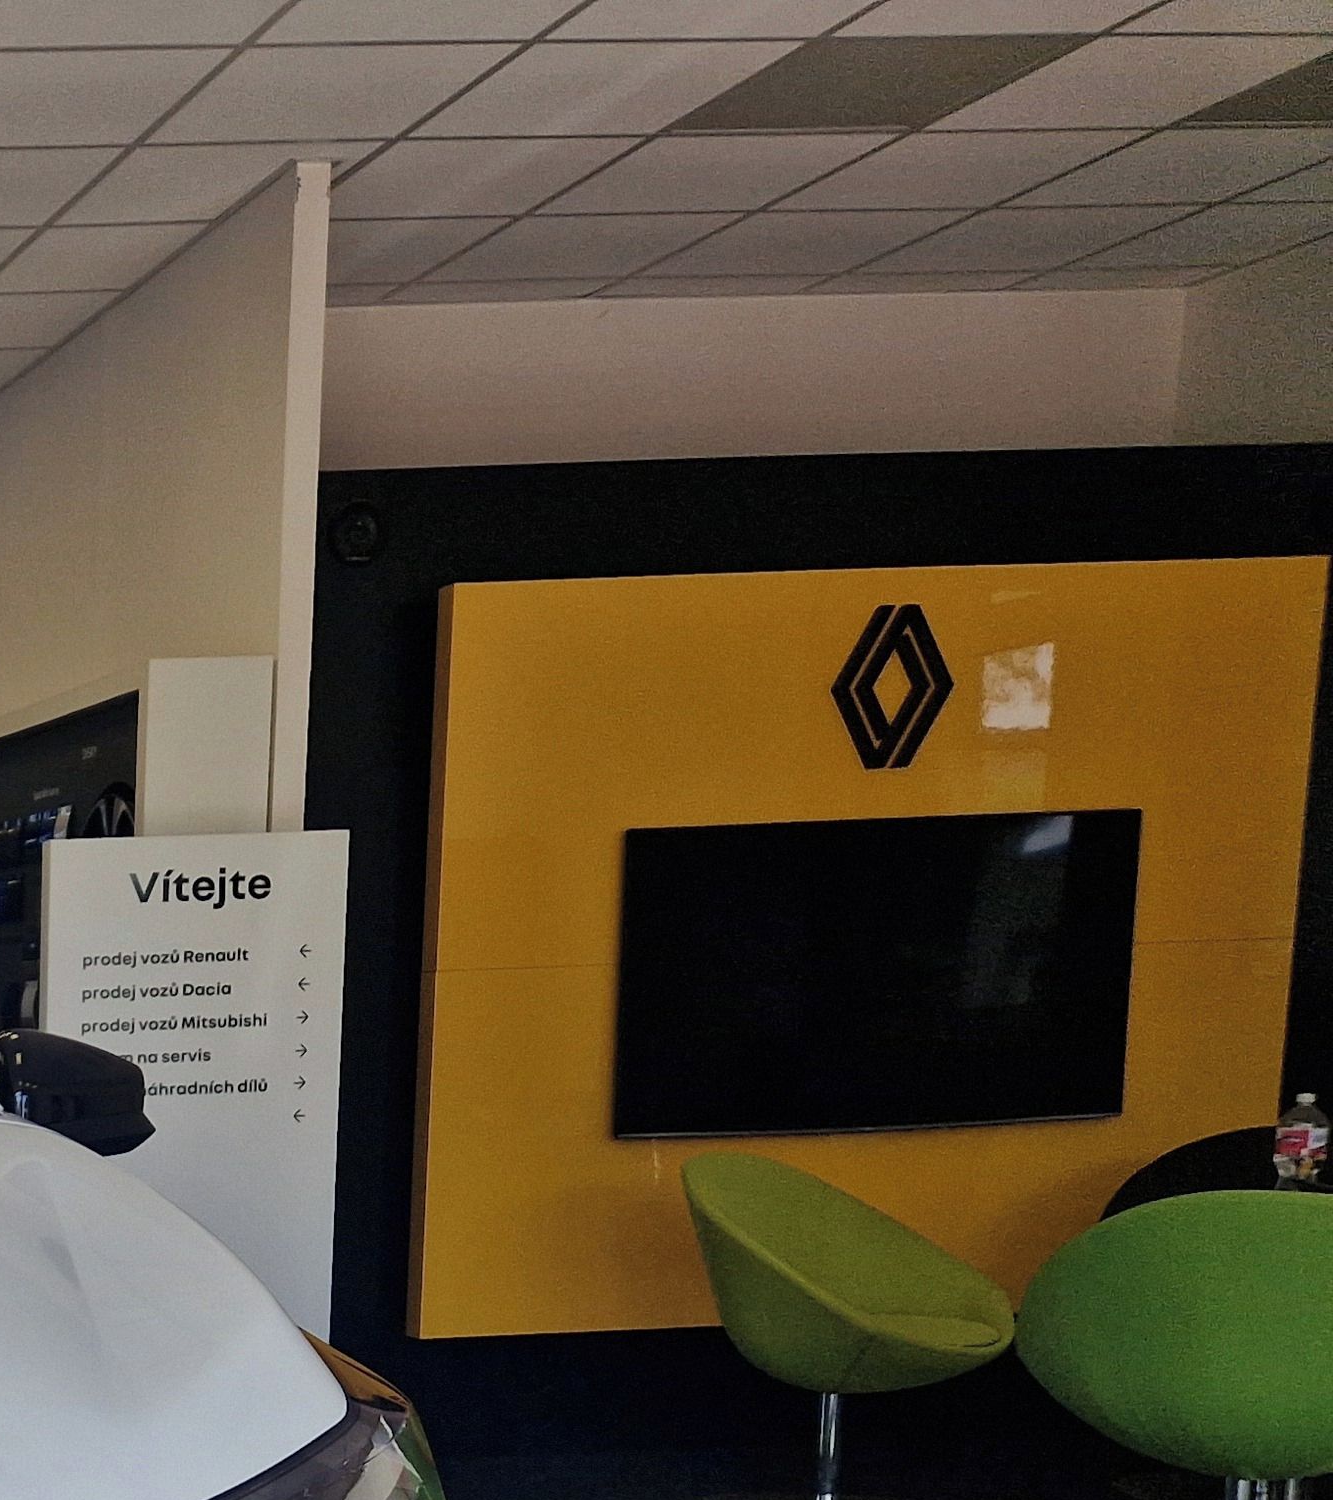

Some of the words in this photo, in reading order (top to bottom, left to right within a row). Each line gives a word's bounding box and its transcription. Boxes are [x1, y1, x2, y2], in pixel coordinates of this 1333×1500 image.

[129, 867, 272, 909] Vítejte
[82, 951, 137, 969] prodej
[140, 949, 180, 965] vozů
[183, 948, 249, 963] Renault
[82, 985, 136, 1003] prodej
[139, 982, 179, 998] vozů
[182, 982, 232, 996] Dacia
[81, 1018, 135, 1036] prodej
[139, 1016, 178, 1031] vozů
[182, 1013, 268, 1029] Mitsubishi
[137, 1052, 158, 1064] na
[161, 1048, 212, 1063] servis
[144, 1080, 234, 1097] áhradních
[237, 1078, 268, 1094] dílů
